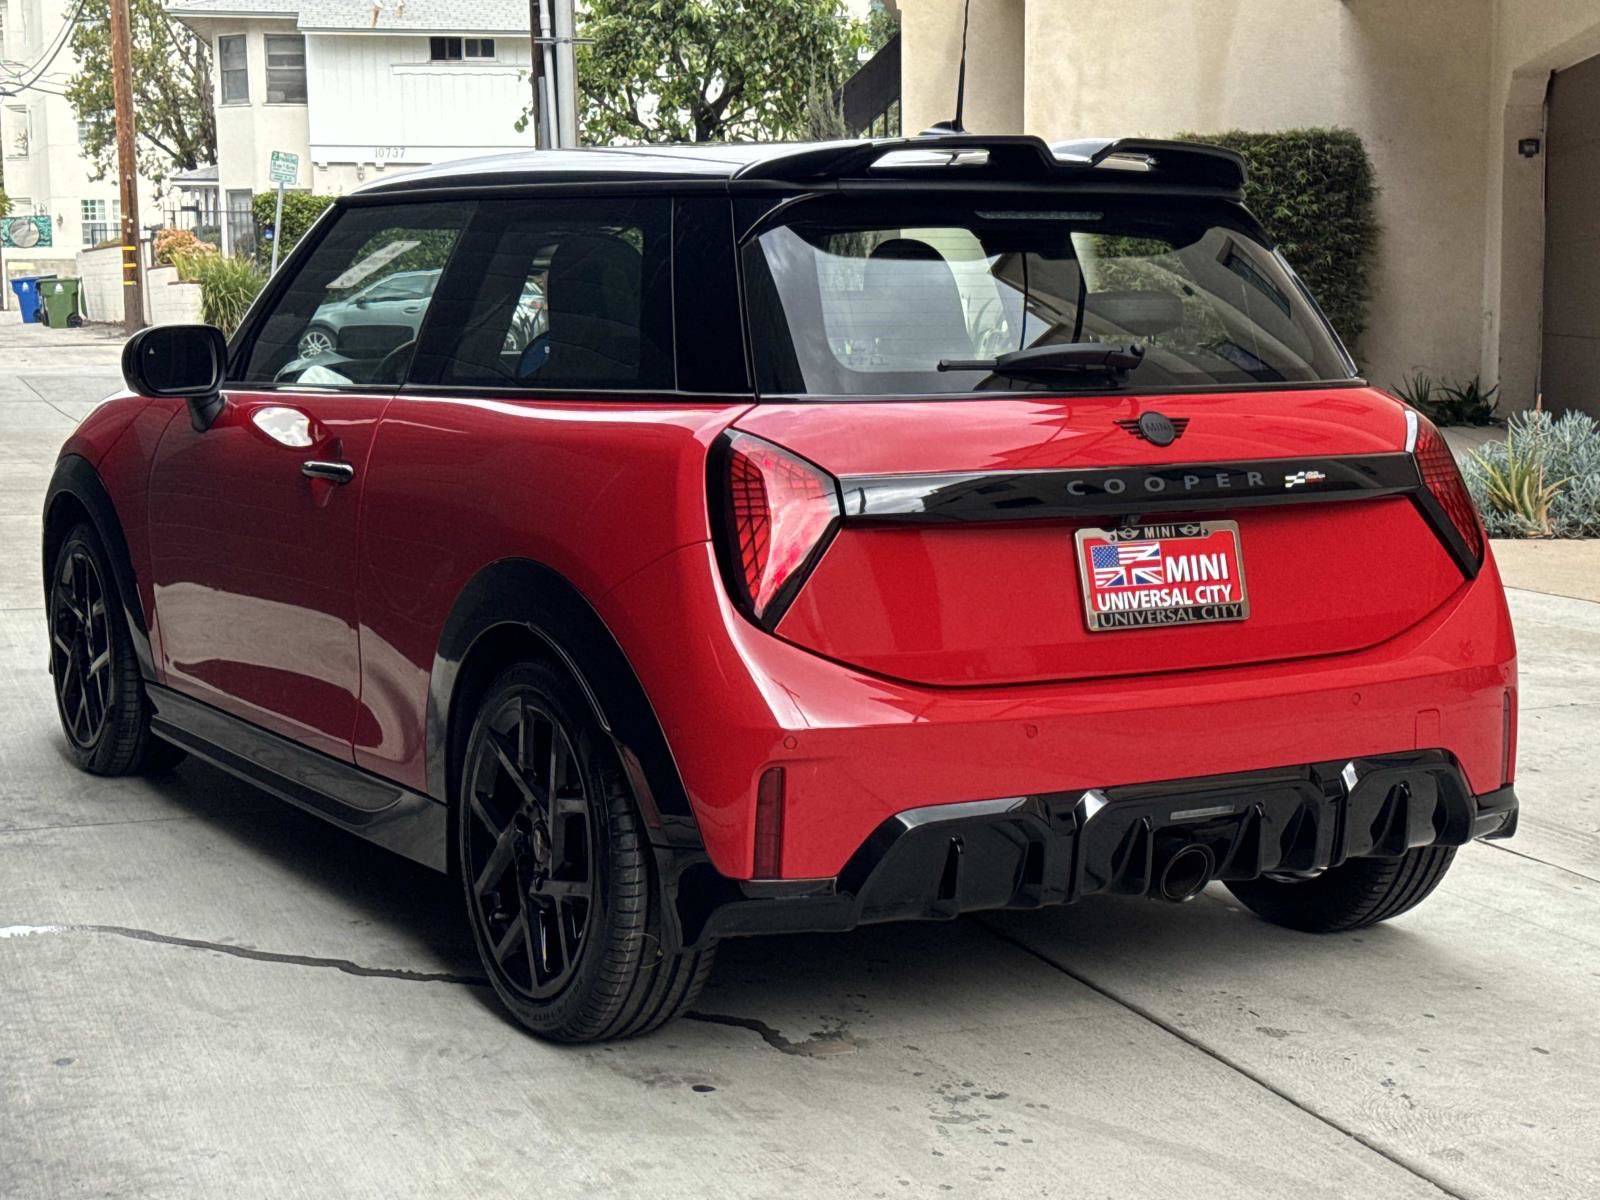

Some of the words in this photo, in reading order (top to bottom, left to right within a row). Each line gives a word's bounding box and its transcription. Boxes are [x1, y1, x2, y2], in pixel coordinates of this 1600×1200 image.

[375, 146, 405, 158] 10737
[1144, 422, 1174, 434] MINI
[1066, 472, 1265, 495] COOPER
[1144, 526, 1176, 539] MINI
[1165, 553, 1229, 583] MINI
[1097, 588, 1194, 611] UNIVERSAL
[1195, 584, 1232, 605] CITY
[1100, 607, 1198, 628] UNIVERSAL
[1201, 604, 1240, 620] CITY
